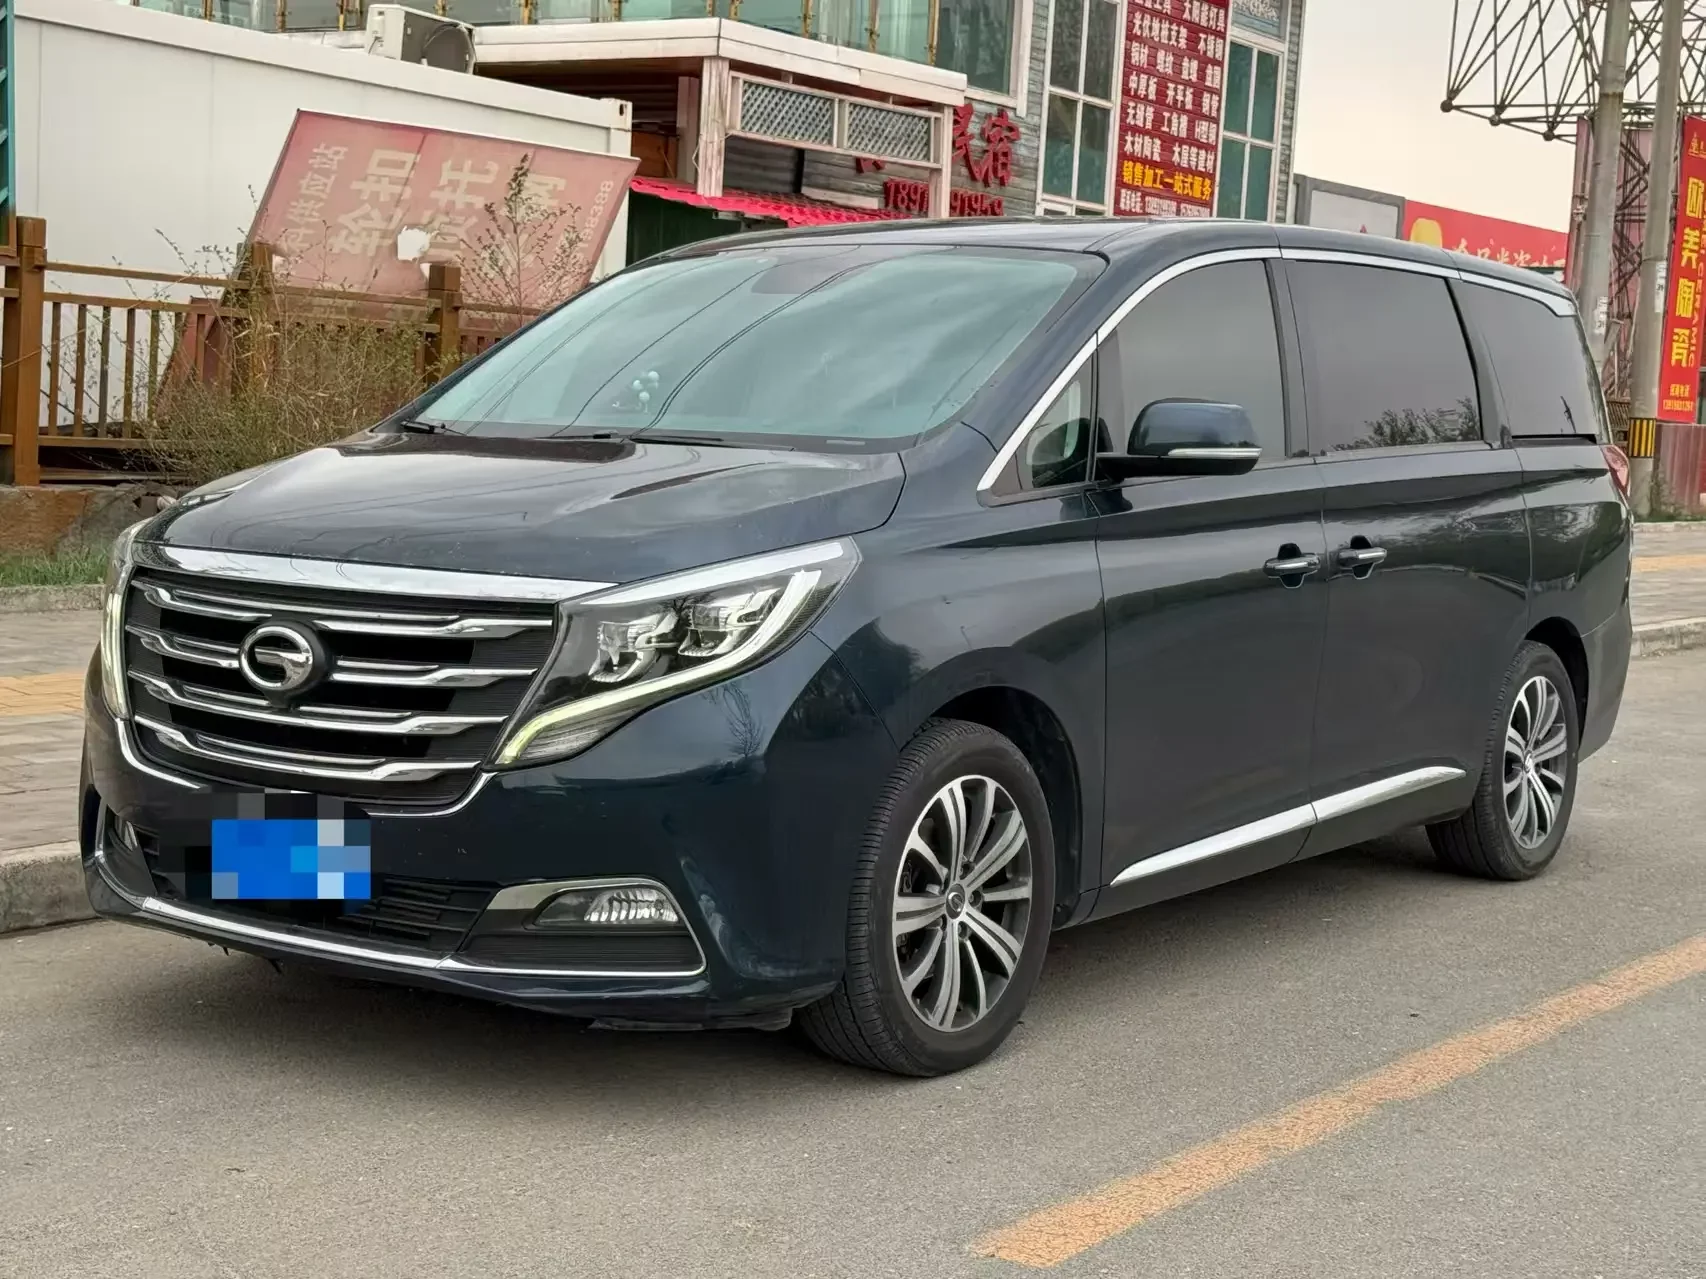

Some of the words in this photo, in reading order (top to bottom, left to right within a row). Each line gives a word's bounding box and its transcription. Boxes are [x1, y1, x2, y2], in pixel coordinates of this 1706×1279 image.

[1197, 33, 1224, 61] 不锈钢
[1129, 71, 1157, 101] 中厚板
[1166, 83, 1194, 110] 开平板
[1122, 160, 1212, 200] 销售加工一站式服务
[327, 148, 421, 256] 轮扣
